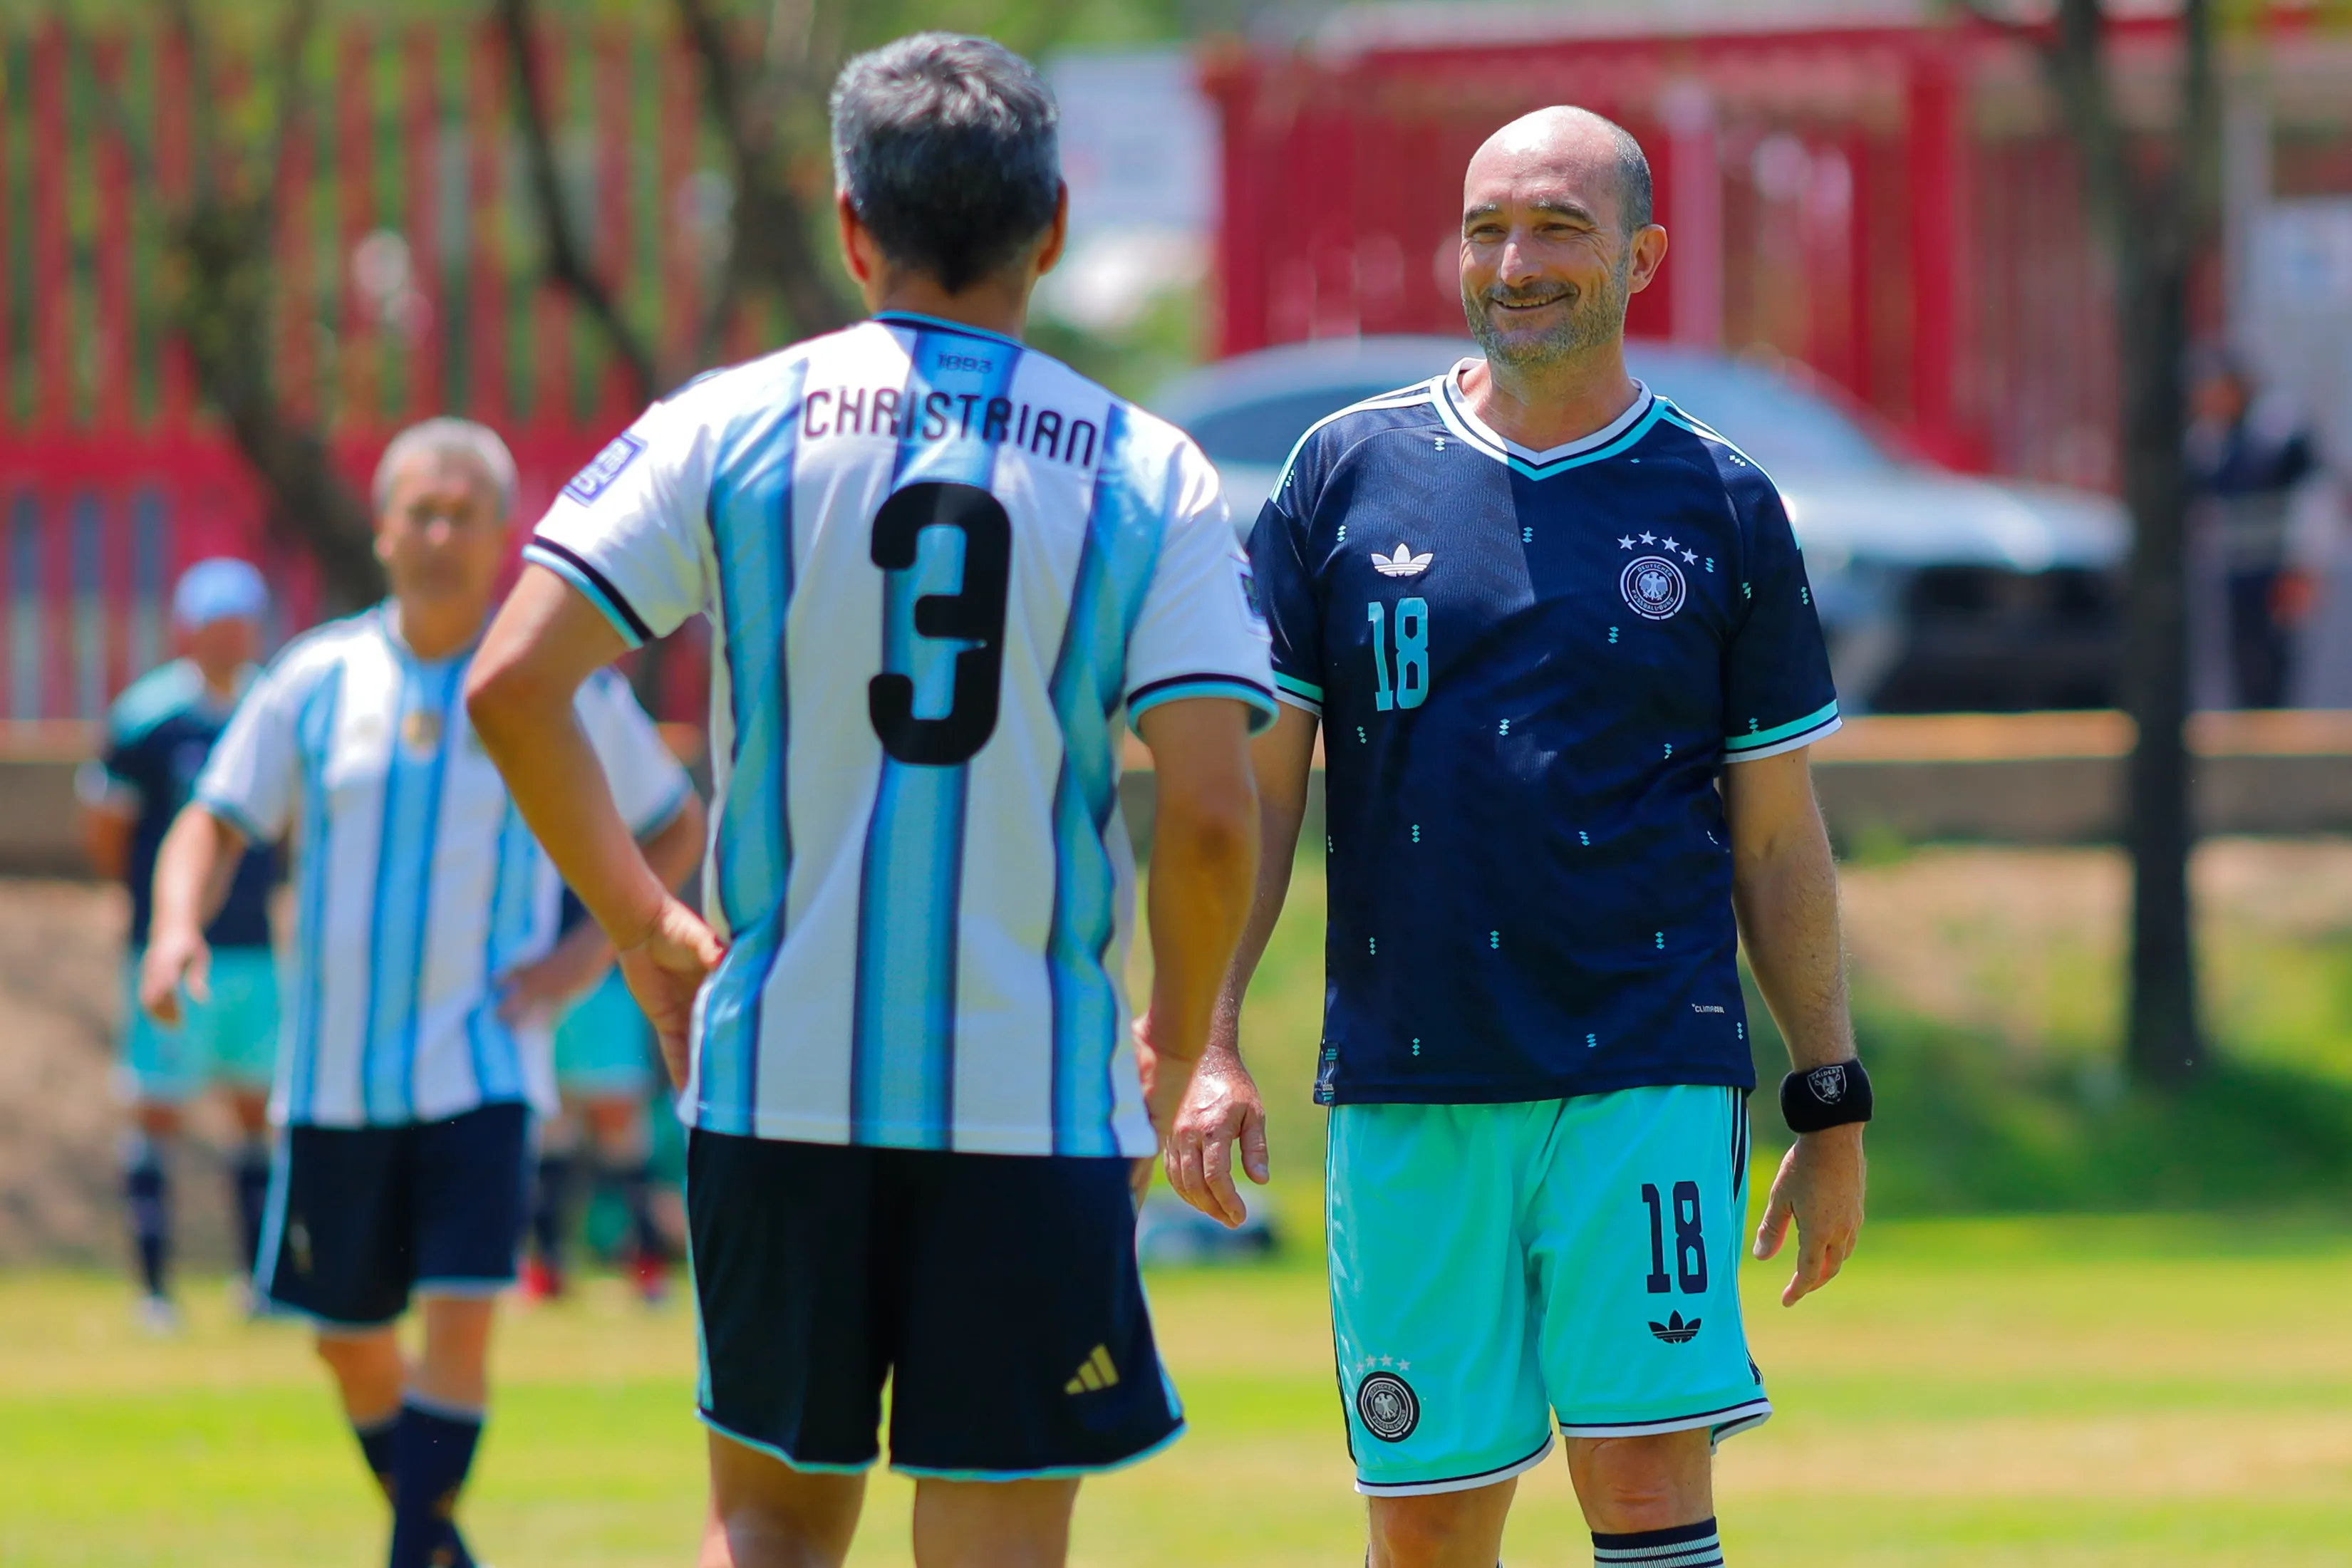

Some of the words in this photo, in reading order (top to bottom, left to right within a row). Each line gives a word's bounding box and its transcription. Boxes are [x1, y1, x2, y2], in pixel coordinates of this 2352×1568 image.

[938, 352, 993, 373] 1893
[803, 387, 1098, 468] CHRISTRIAN
[1637, 563, 1673, 577] DEUTSCHER
[868, 482, 1012, 767] 3
[1367, 597, 1429, 712] 18
[1641, 1180, 1708, 1295] 18
